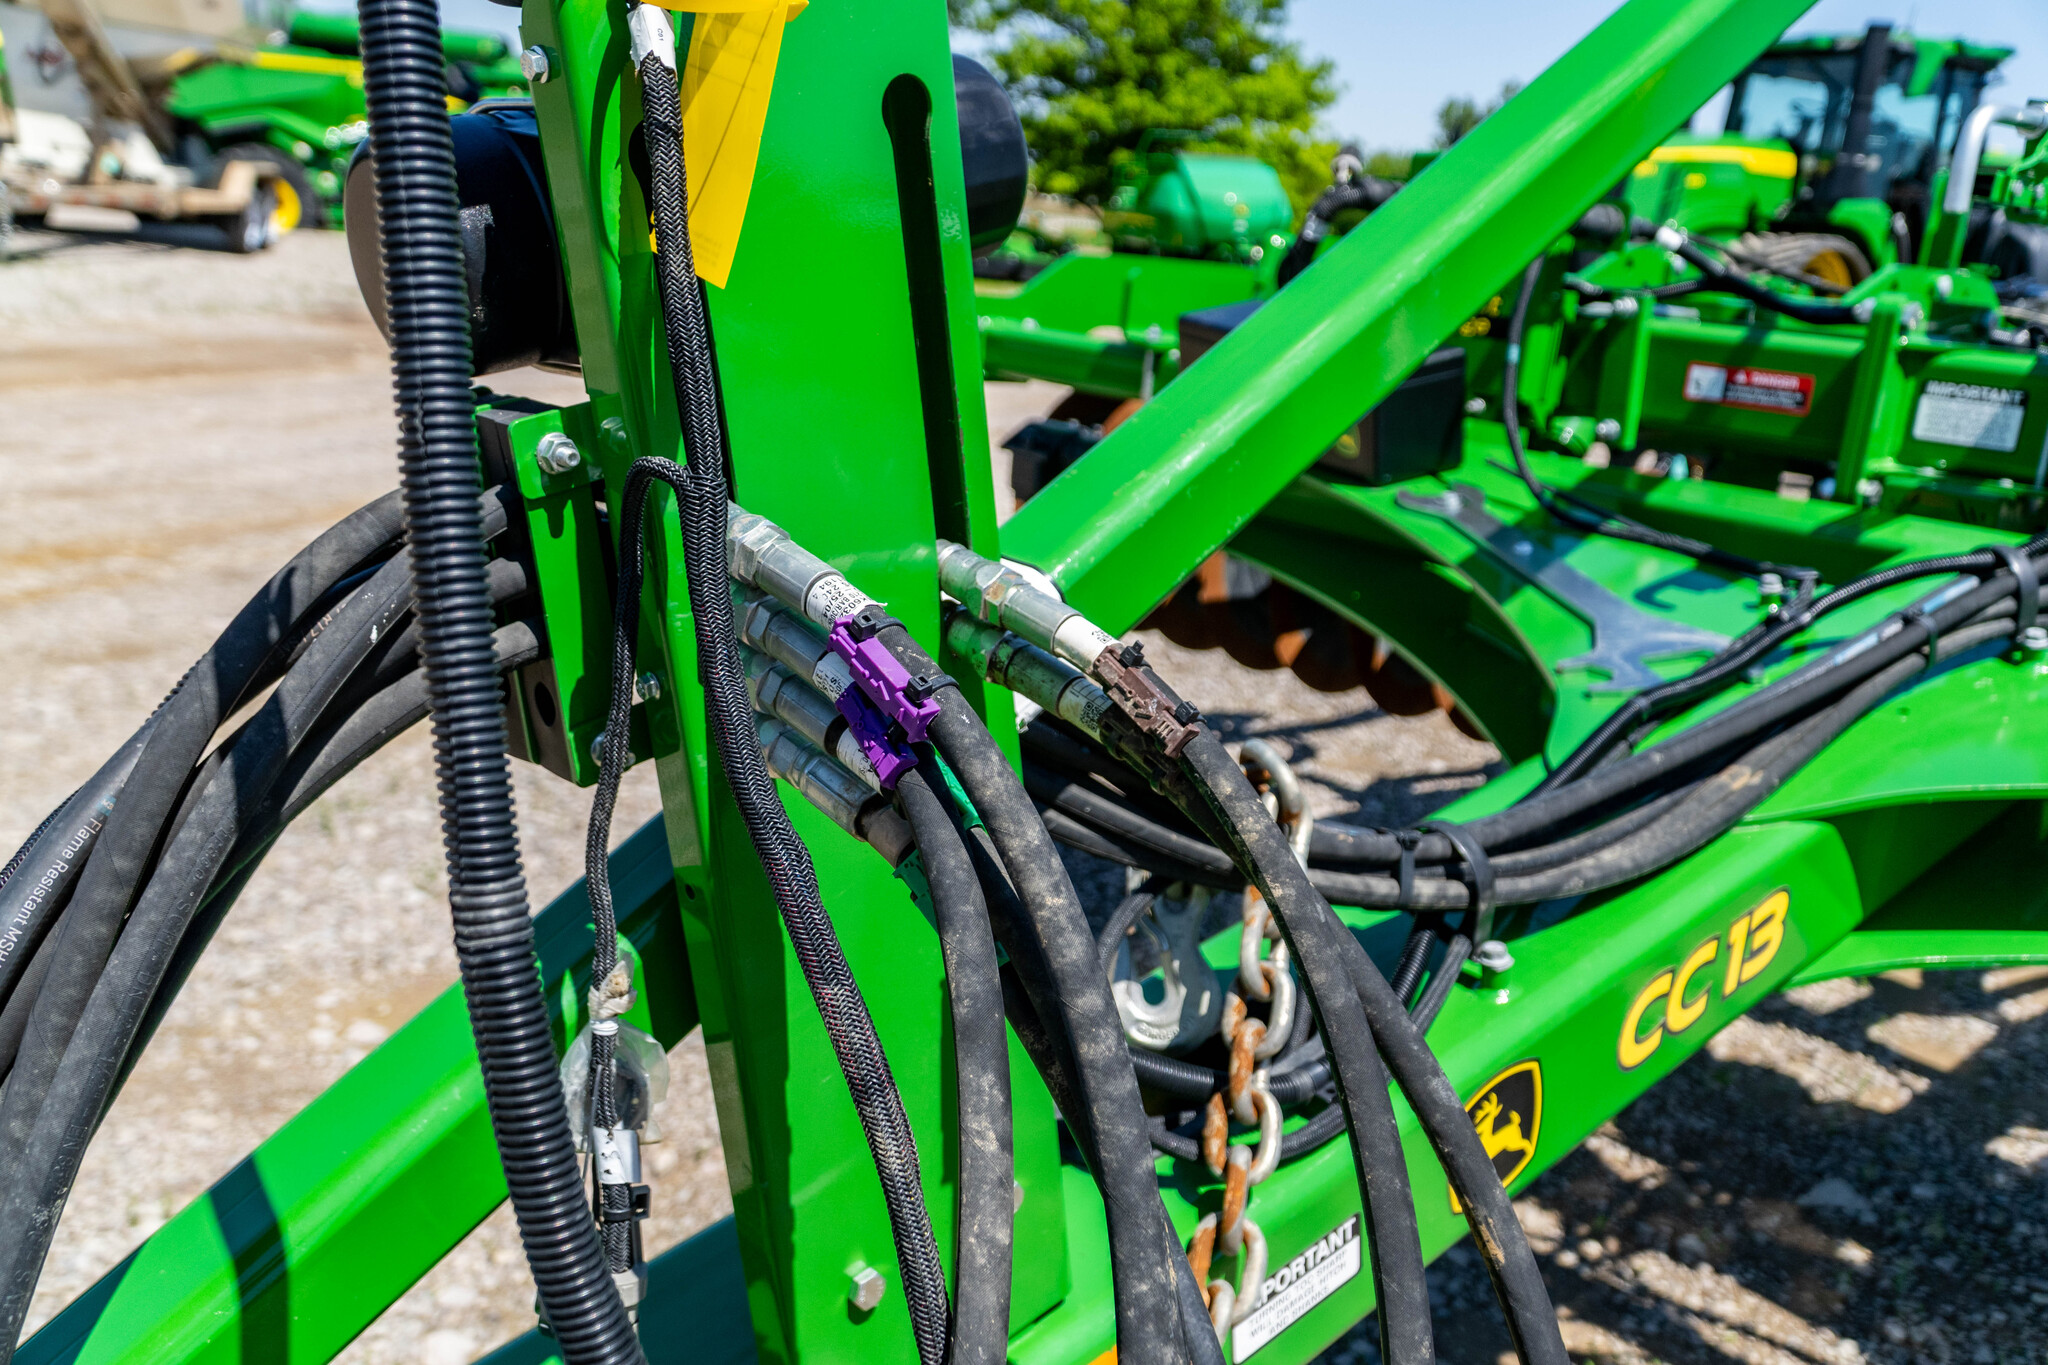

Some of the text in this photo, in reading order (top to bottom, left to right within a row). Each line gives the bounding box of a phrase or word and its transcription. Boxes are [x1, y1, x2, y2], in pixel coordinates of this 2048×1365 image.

[1925, 380, 2025, 405] IMPORTANT
[62, 817, 102, 860] Flame
[13, 859, 70, 926] Resistant
[1256, 1216, 1357, 1309] PORTANT
